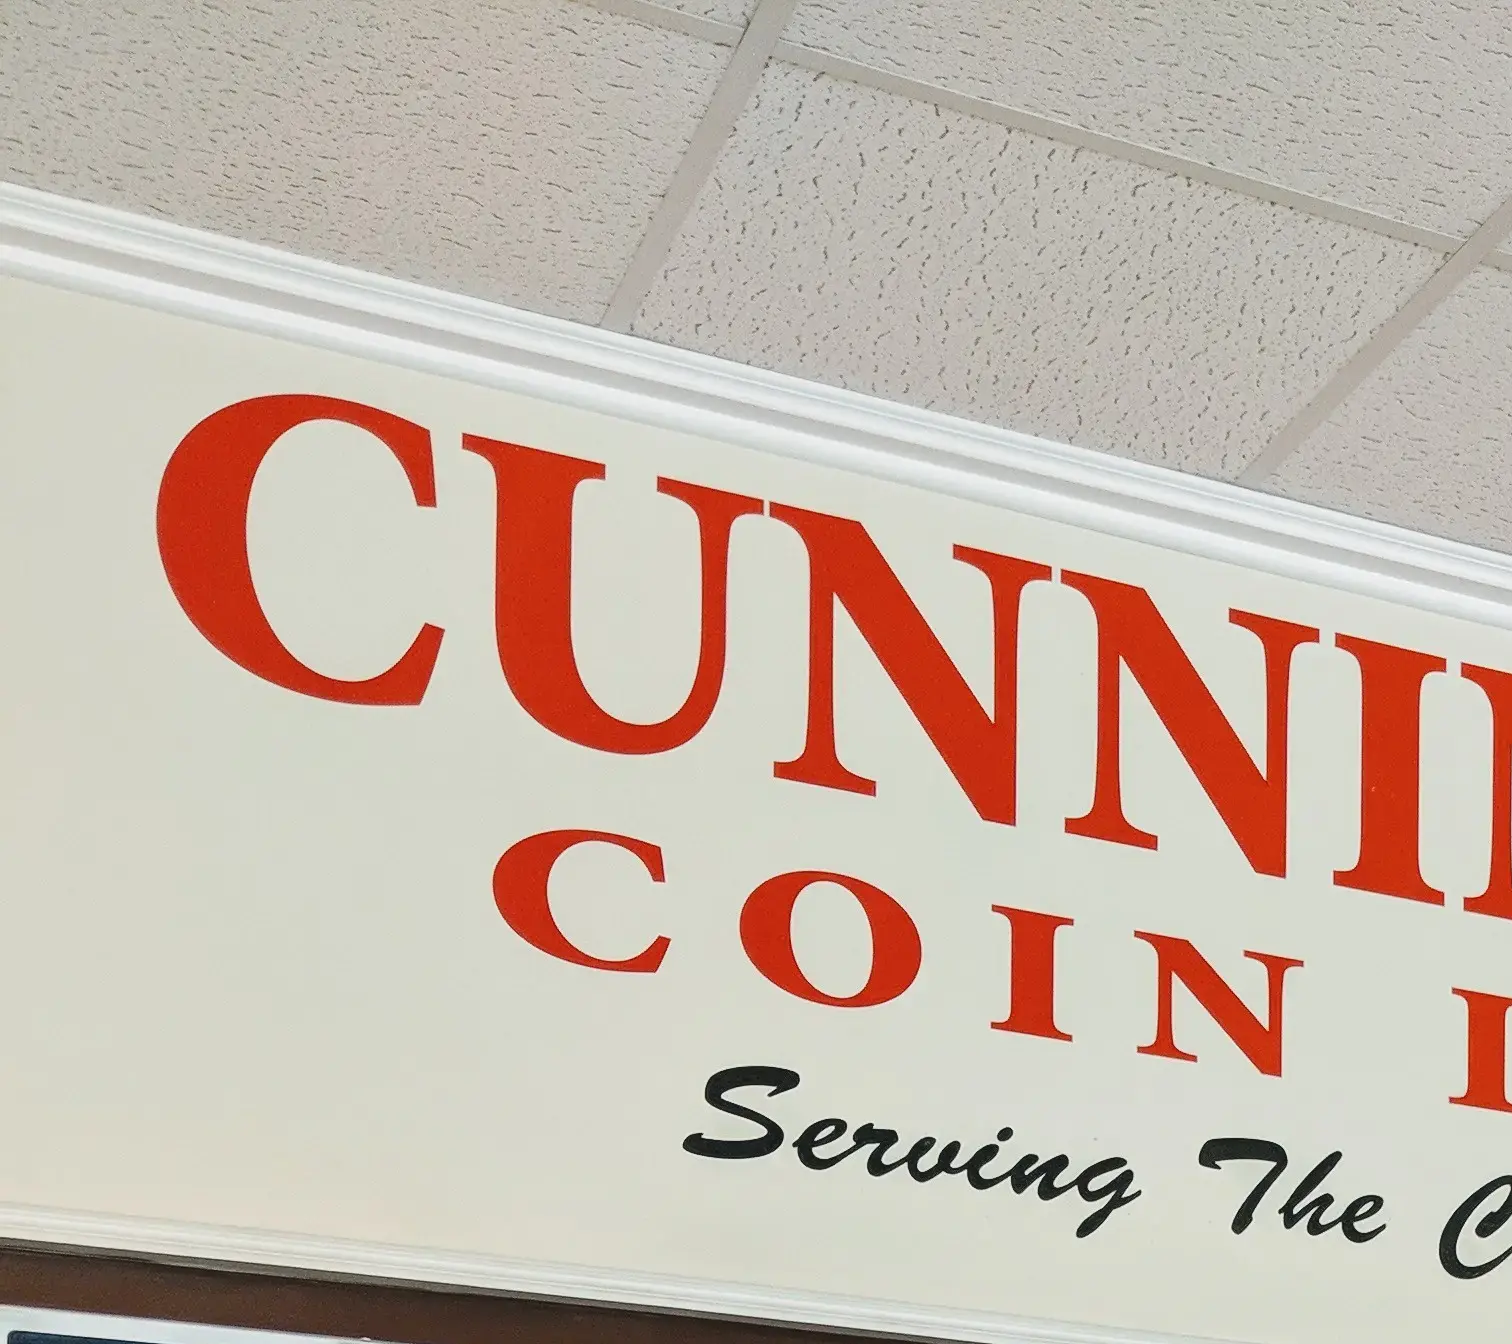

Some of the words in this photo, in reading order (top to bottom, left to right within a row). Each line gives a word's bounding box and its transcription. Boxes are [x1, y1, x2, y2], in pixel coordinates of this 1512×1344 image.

[491, 828, 1304, 1078] COIN
[683, 1066, 1142, 1239] Serving
[1199, 1138, 1388, 1244] The
